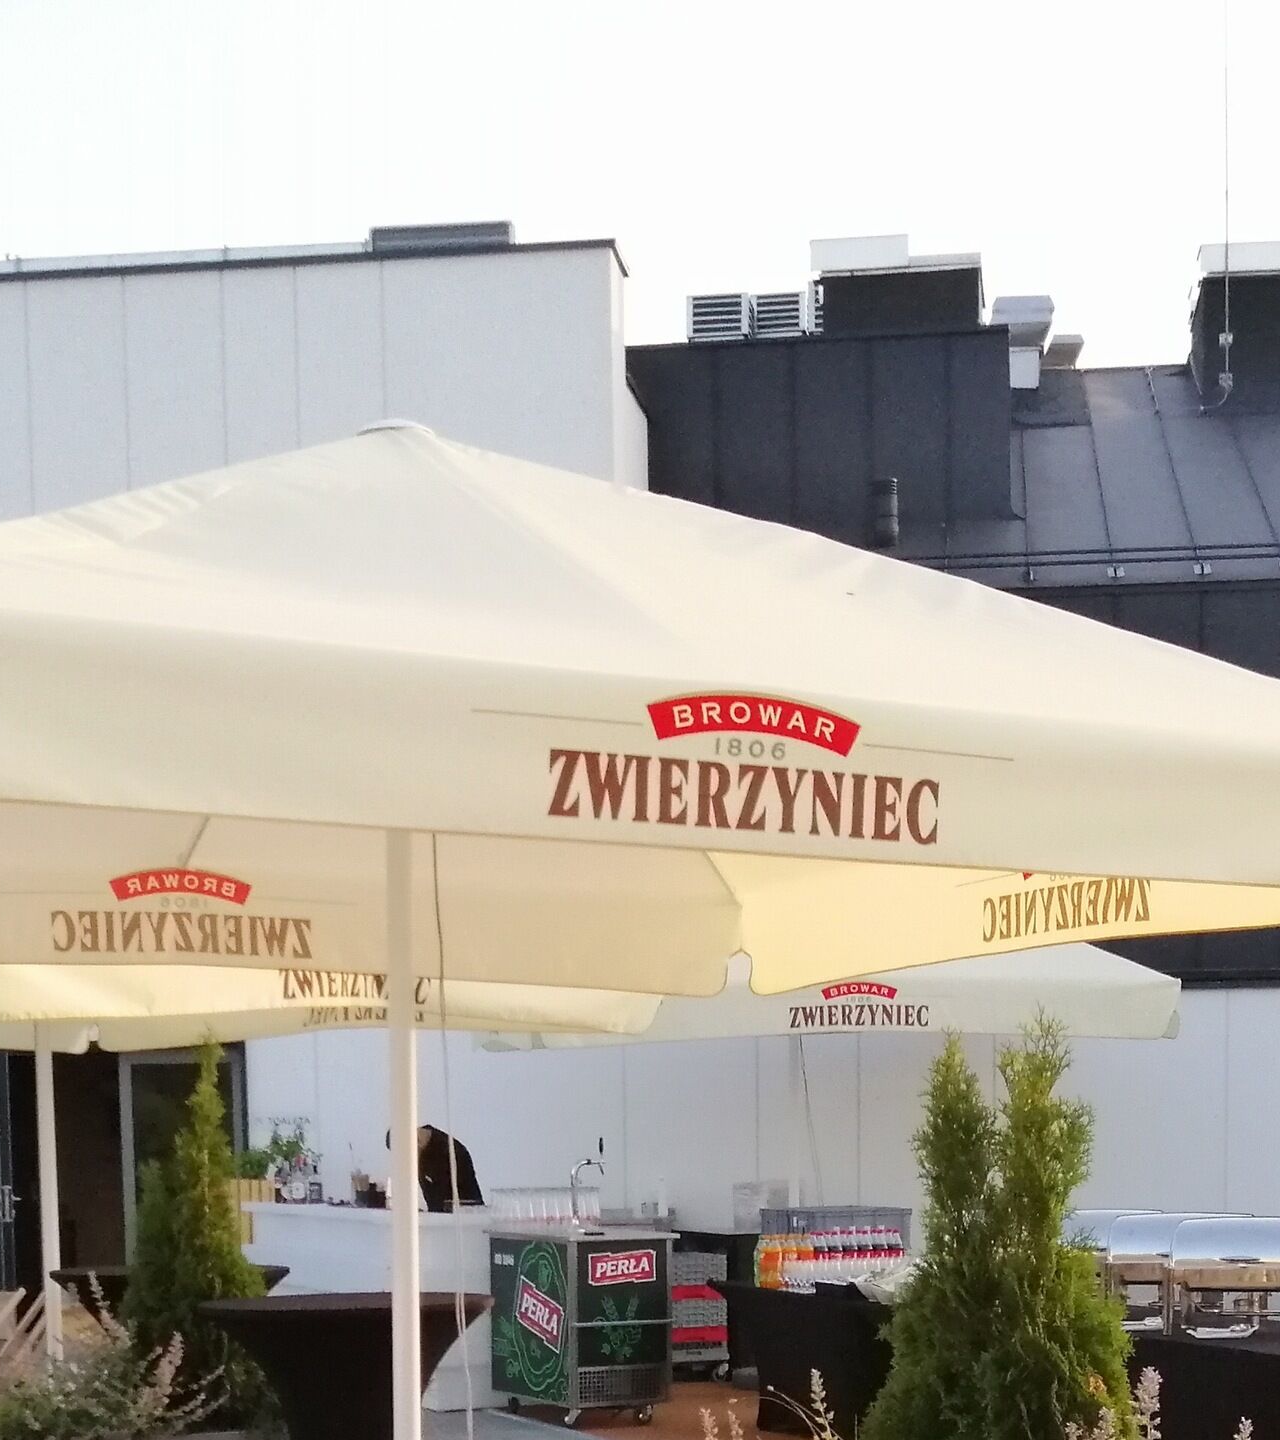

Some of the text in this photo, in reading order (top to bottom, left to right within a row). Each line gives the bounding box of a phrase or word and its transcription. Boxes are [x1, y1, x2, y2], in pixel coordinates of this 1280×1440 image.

[672, 702, 836, 743] BROWAR
[714, 737, 787, 761] 1806
[547, 748, 941, 846] ZWIERZYNIEC
[279, 968, 431, 1005] ZWIERZYNC
[829, 984, 890, 998] BROWAR
[789, 1003, 930, 1029] ZWIERZYNIEC
[595, 1257, 650, 1278] PERŁA
[521, 1293, 558, 1335] PERŁA
